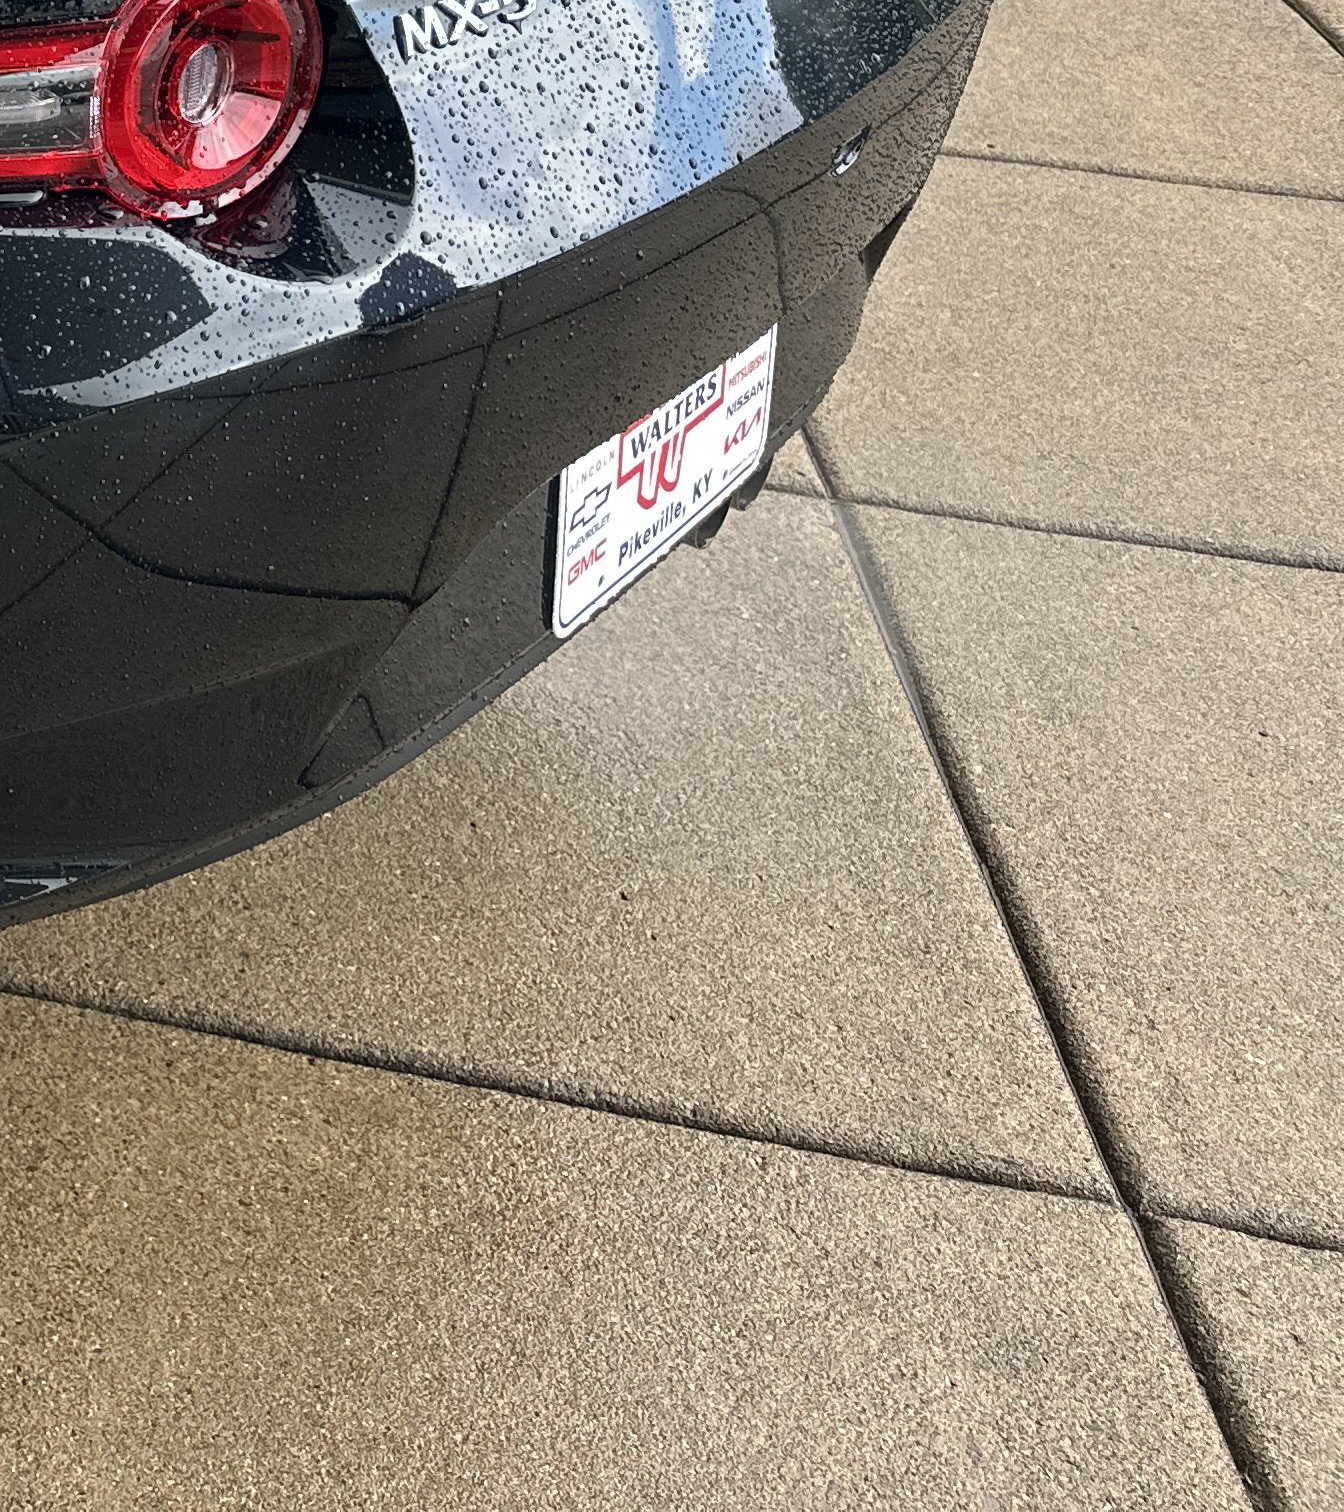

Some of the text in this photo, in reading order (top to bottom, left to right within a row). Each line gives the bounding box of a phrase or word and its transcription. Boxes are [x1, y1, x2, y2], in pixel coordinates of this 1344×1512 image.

[630, 372, 717, 460] WALTERS
[726, 377, 766, 421] NISSAN
[568, 449, 616, 495] LINCOLN
[566, 511, 612, 558] CHEVROLET
[618, 467, 714, 568] Pikeville, KY
[567, 537, 608, 586] GMC
